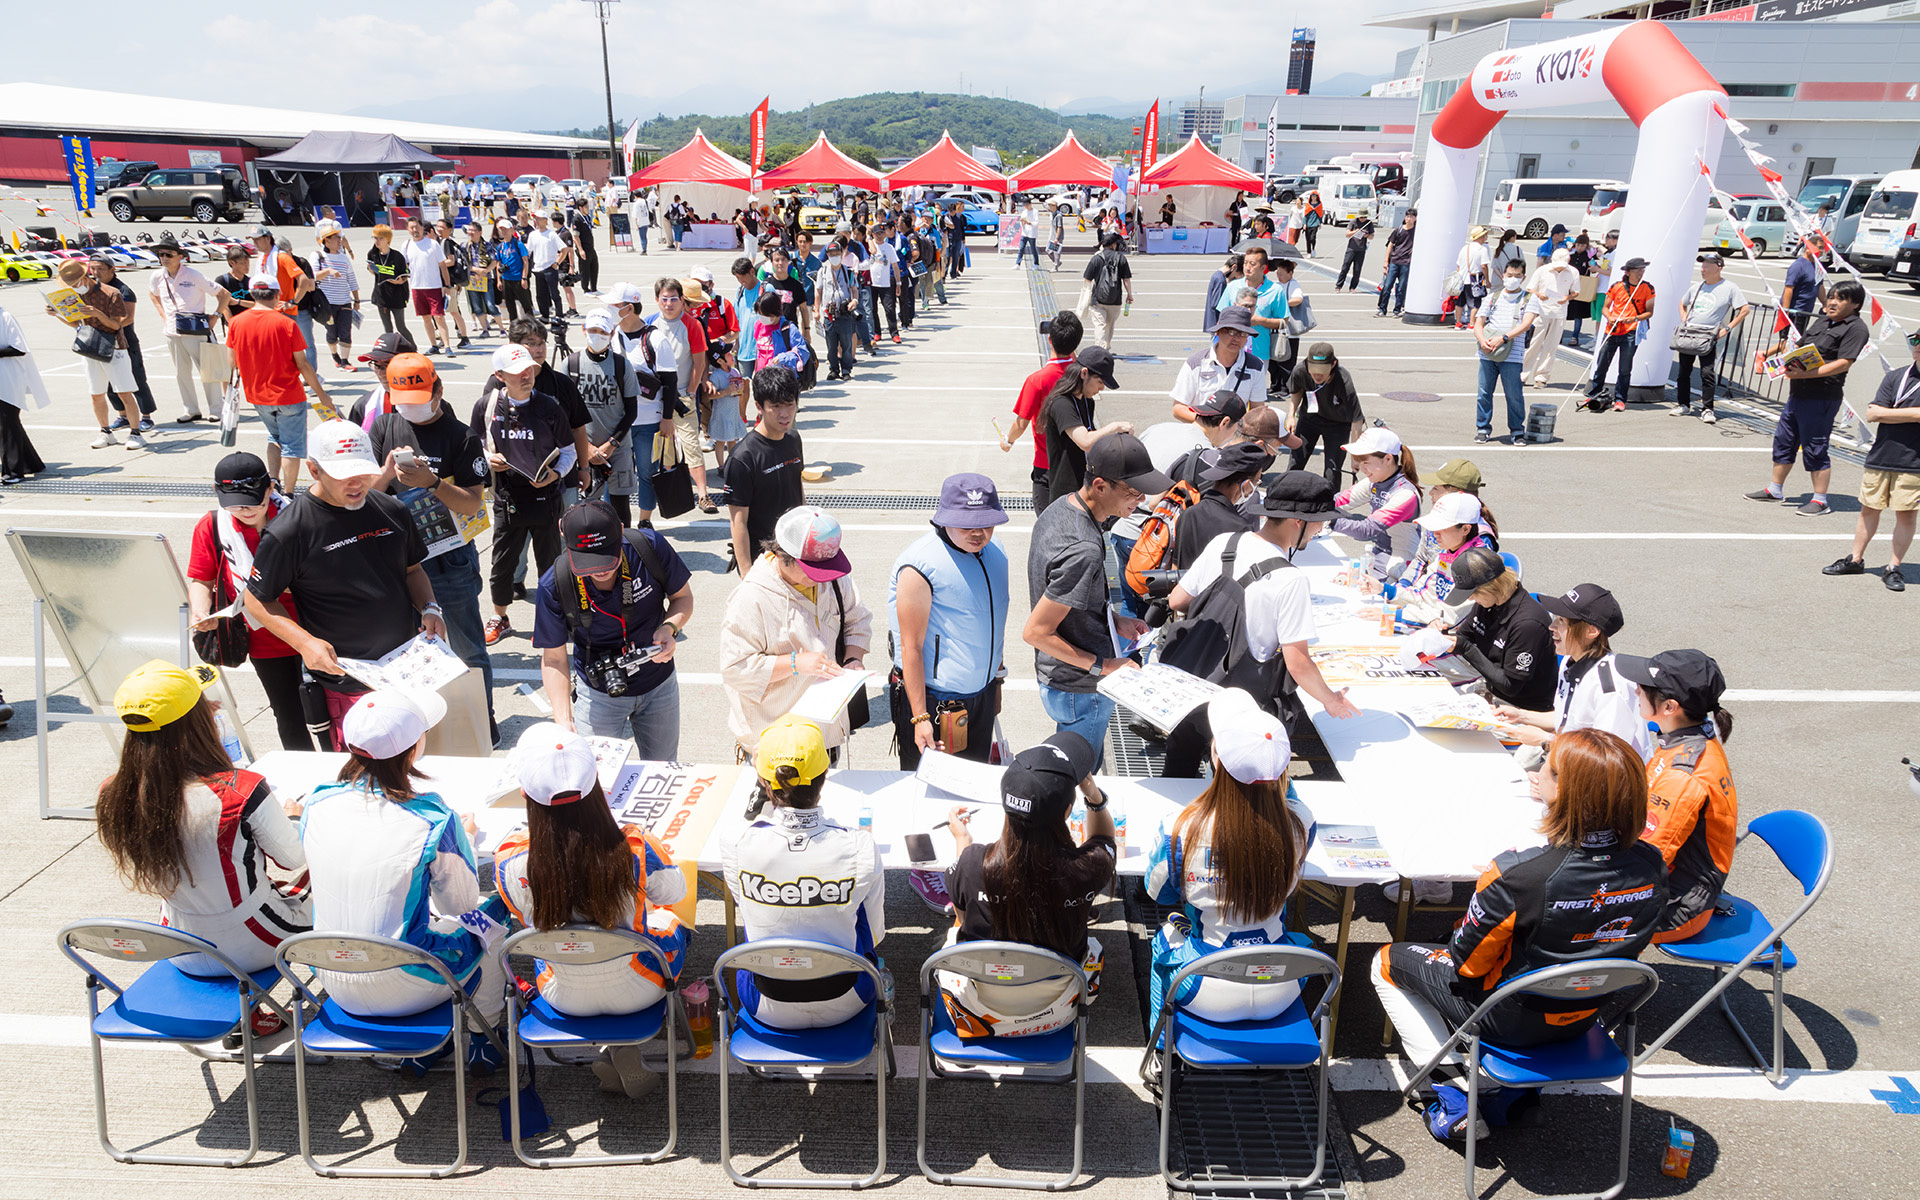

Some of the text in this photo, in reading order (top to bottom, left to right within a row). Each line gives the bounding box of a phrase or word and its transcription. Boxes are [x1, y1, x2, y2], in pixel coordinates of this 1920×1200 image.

[1905, 84, 1918, 100] 4
[71, 138, 89, 209] GOODYEAR
[392, 374, 425, 386] ARTA
[329, 536, 358, 552] DRIVING
[621, 772, 640, 792] Good
[682, 775, 717, 806] You
[739, 874, 855, 905] KeePer
[1552, 888, 1654, 910] FIRST GARAGE
[532, 943, 546, 952] 36
[1232, 936, 1263, 948] sparco
[1219, 963, 1236, 973] 34
